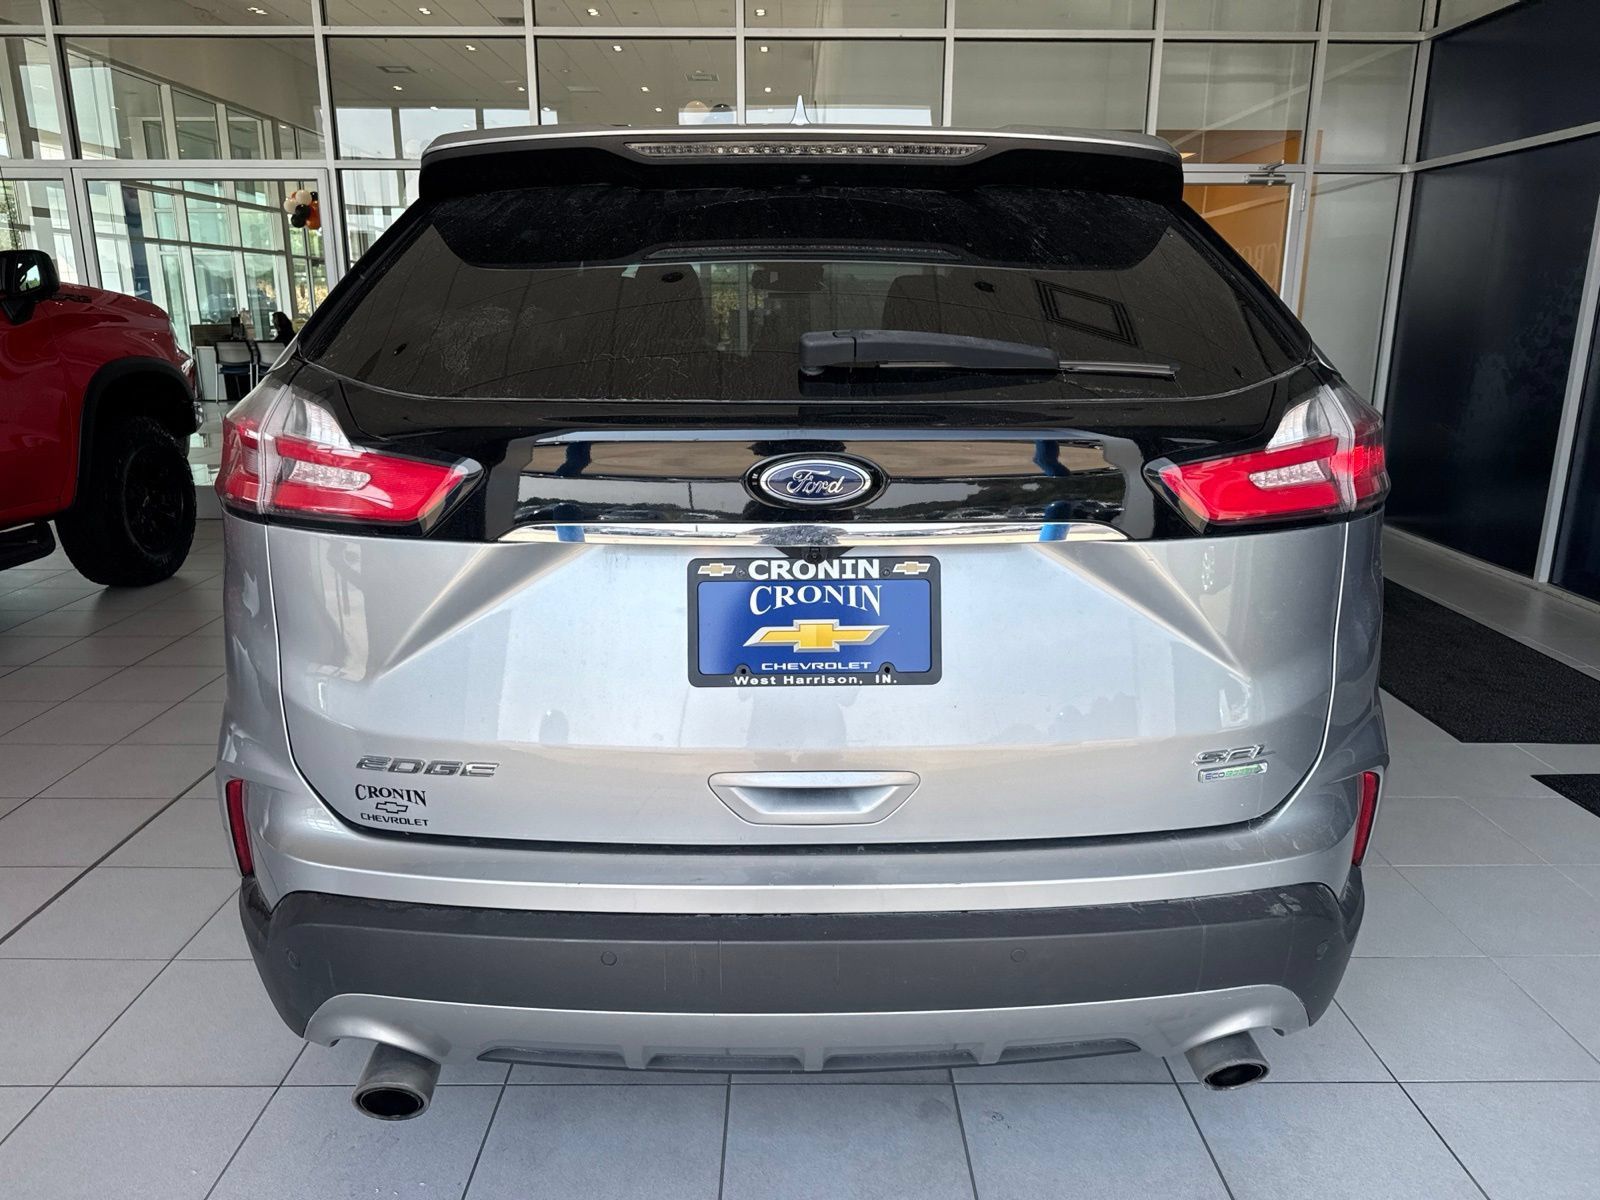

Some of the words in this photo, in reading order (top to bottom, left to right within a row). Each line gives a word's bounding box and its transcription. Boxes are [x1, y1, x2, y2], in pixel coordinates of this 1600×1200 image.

[786, 469, 844, 495] Ford
[748, 559, 880, 580] CRONIN
[749, 585, 882, 616] CRONIN
[761, 661, 872, 671] CHEVROLET
[734, 675, 776, 685] West
[783, 674, 863, 685] Harrison,
[875, 674, 897, 684] IN.
[356, 755, 500, 777] EDGE
[355, 784, 427, 807] CRONIN
[360, 812, 429, 827] CHEVROLET
